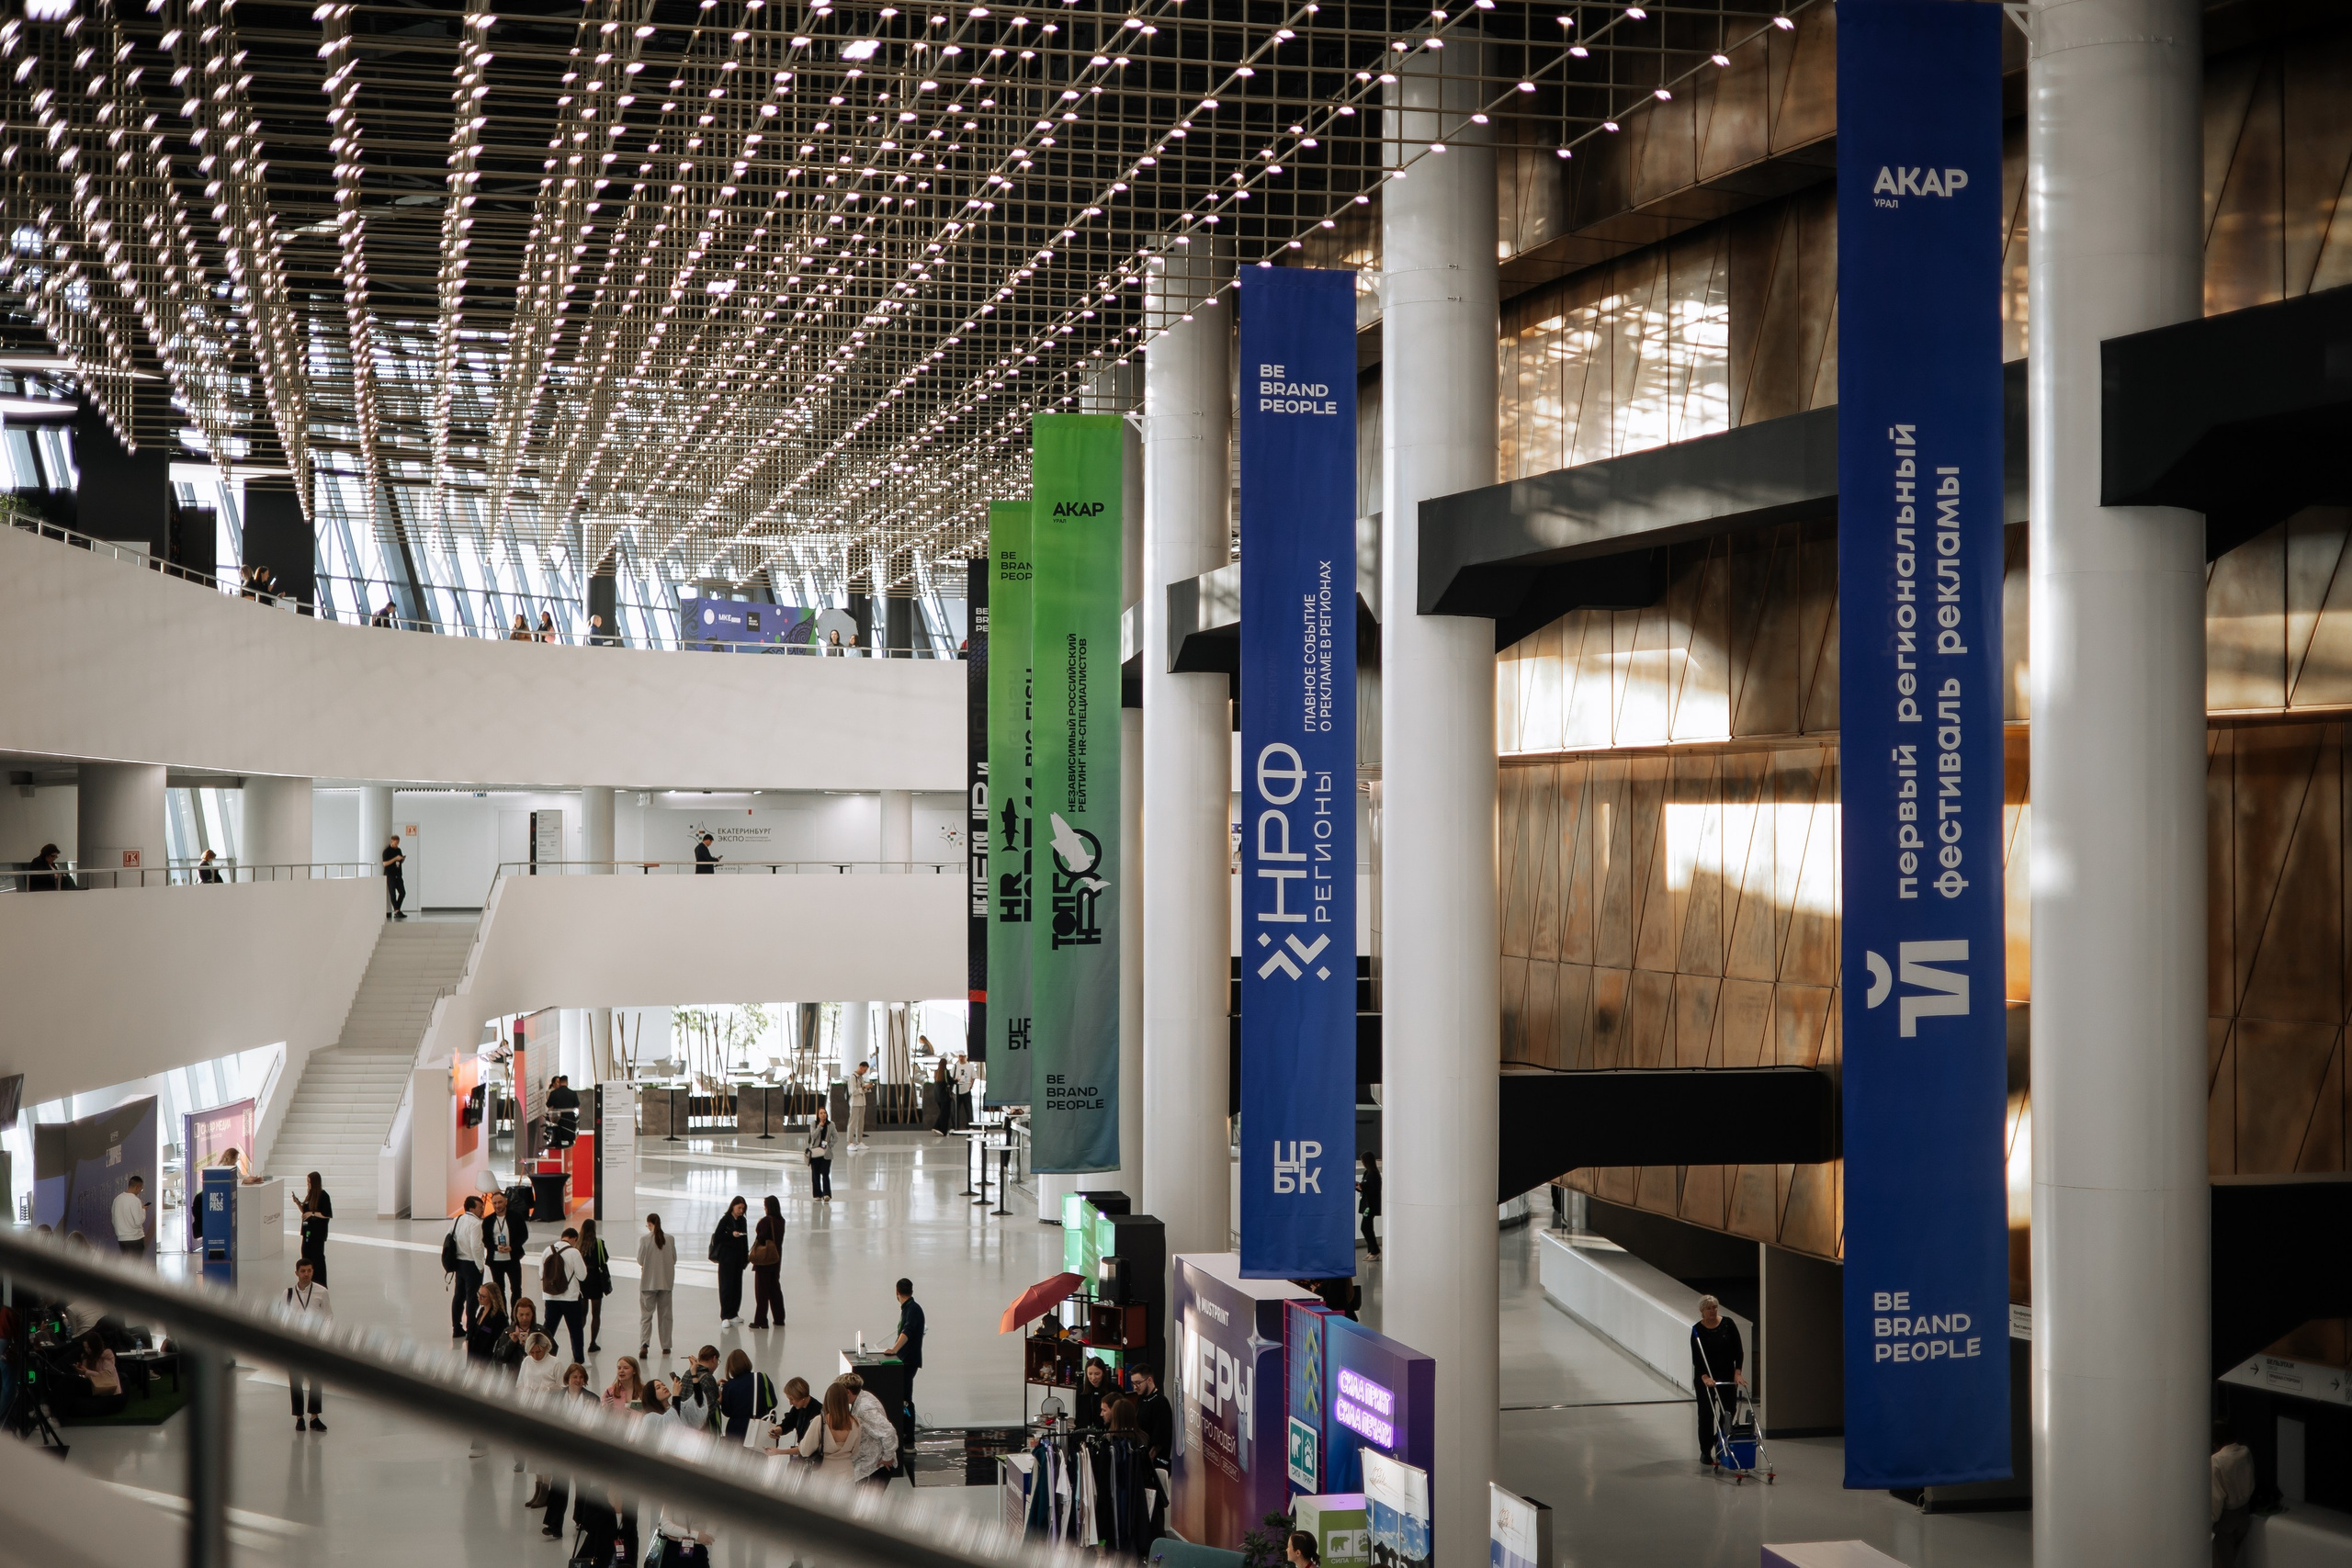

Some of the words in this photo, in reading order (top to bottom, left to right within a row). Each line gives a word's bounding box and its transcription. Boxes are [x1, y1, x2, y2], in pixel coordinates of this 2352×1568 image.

[1873, 166, 1969, 197] АКАР
[1874, 198, 1899, 209] УРАЛ
[1260, 364, 1285, 378] BE
[1260, 381, 1329, 398] BRAND
[1260, 399, 1338, 415] PEOPLE
[1053, 502, 1105, 517] АКАР
[1001, 551, 1017, 559] BE
[1001, 561, 1033, 570] BRAN
[1933, 467, 1967, 654] рекламы
[1001, 572, 1033, 581] PEOP
[1889, 424, 1924, 723] региональный
[976, 607, 989, 615] BE
[1320, 560, 1332, 637] РЕГИОНАХ
[1305, 593, 1317, 665] СОБЫТИЕ
[1320, 639, 1331, 649] В
[1066, 633, 1077, 716] РОССИЙСКИЙ
[1319, 651, 1332, 717] РЕКЛАМЕ
[1305, 666, 1317, 732] ГЛАВНОЕ
[1319, 721, 1332, 732] О
[1066, 718, 1077, 813] НЕЗАВИСИМЫЙ
[1077, 758, 1088, 813] РЕЙТИНГ
[1933, 679, 1969, 899] фестиваль
[1257, 742, 1307, 923] НРФ
[1893, 745, 1924, 898] первый
[1315, 772, 1331, 923] РЕГИОНЫ
[1000, 873, 1023, 922] HR
[1046, 1074, 1066, 1084] BE
[1046, 1087, 1098, 1098] BRAND
[1046, 1099, 1104, 1111] PEOPLE
[1273, 1140, 1322, 1174] ЦР
[1273, 1167, 1322, 1194] БК
[209, 1201, 224, 1212] PASS
[1201, 1297, 1229, 1327] MUSTPRINT
[1874, 1292, 1910, 1312] BE
[1874, 1314, 1972, 1337] BRAND
[1875, 1337, 1981, 1363] PEOPLE
[1189, 1407, 1201, 1428] ЭТО
[1201, 1416, 1214, 1438] ПРО
[1213, 1426, 1237, 1457] ЛЮДЕЙ
